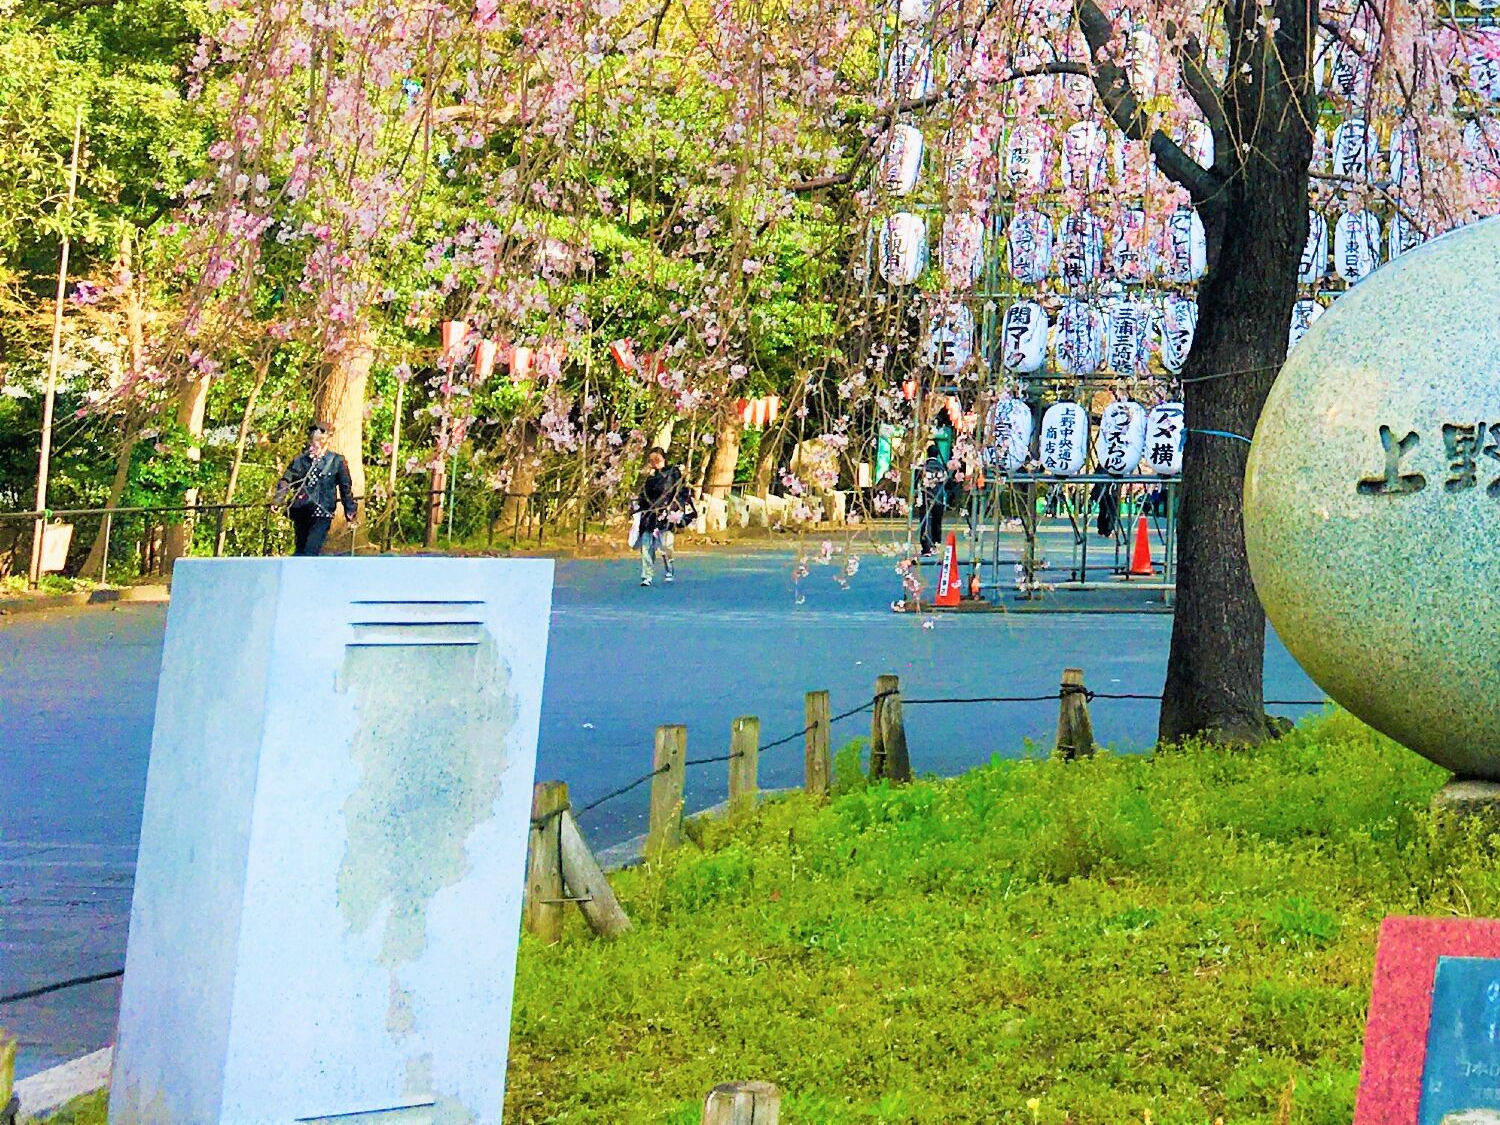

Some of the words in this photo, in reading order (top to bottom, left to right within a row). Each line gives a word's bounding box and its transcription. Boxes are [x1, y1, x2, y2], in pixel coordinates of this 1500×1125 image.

[1045, 426, 1058, 469] 商店会
[1058, 407, 1076, 471] 上野中央通り
[1150, 408, 1184, 468] アメ横
